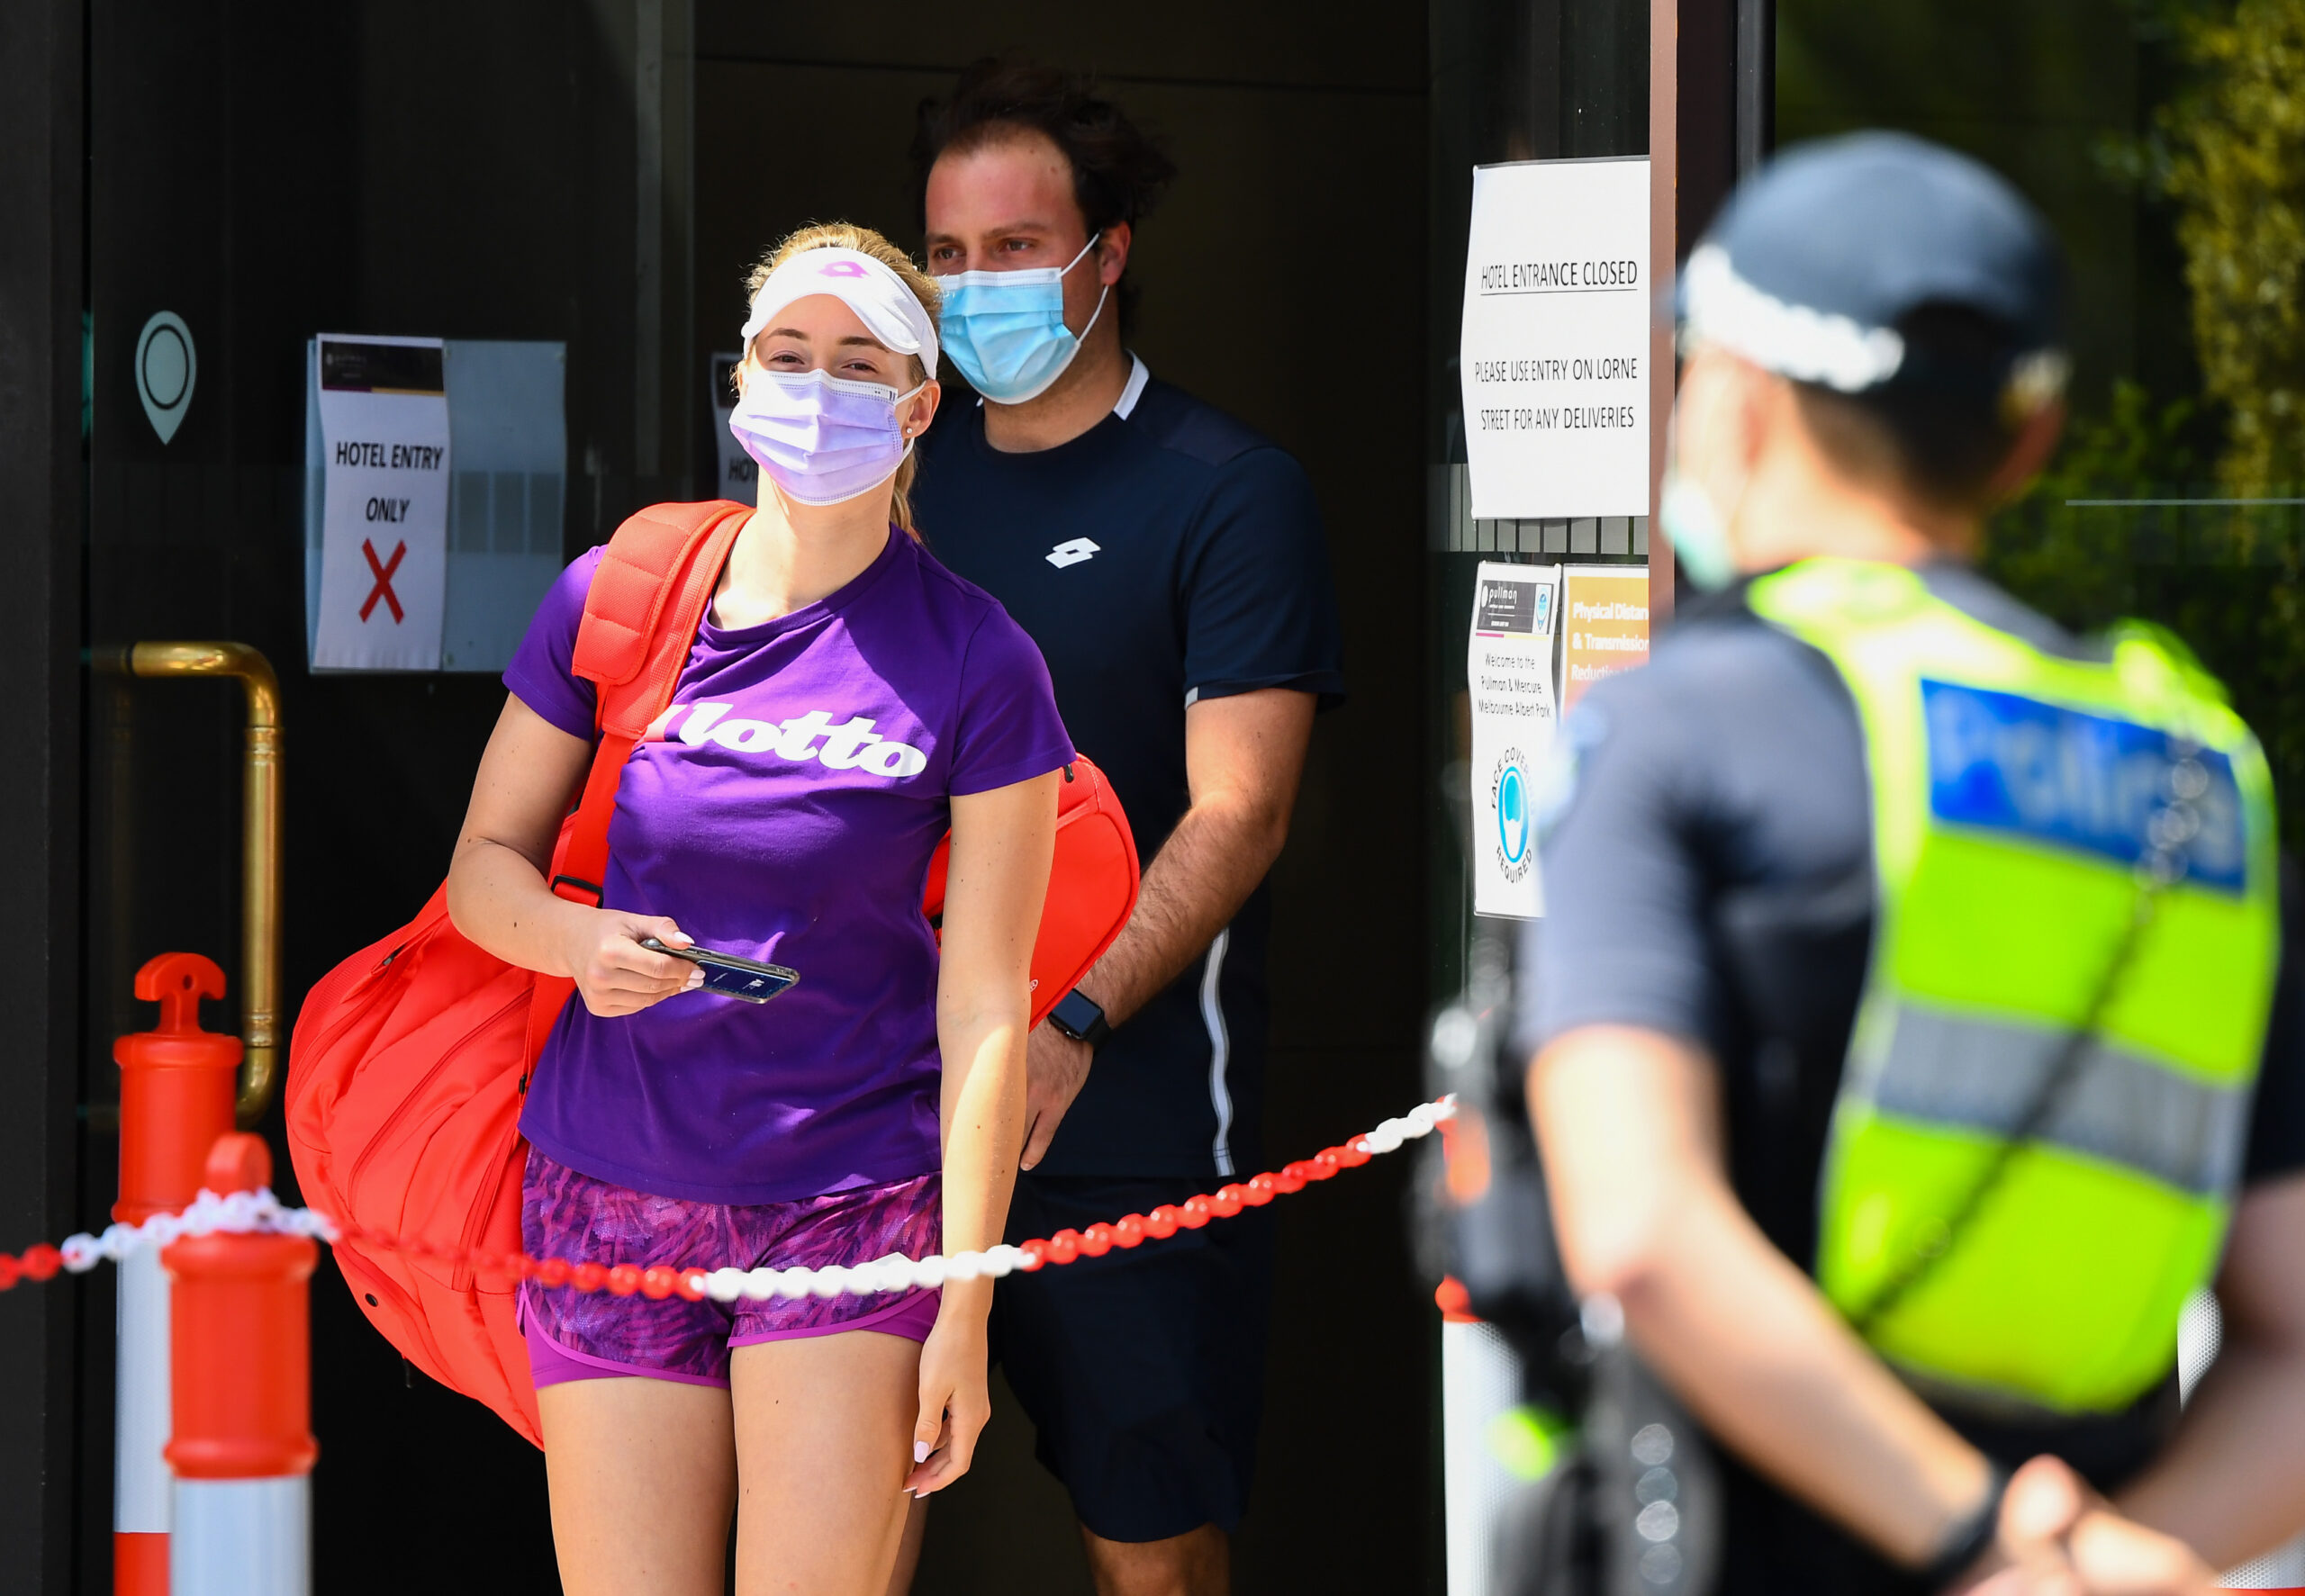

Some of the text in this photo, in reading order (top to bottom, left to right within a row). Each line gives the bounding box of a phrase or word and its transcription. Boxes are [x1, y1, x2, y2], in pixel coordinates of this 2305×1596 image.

[1481, 261, 1637, 289] HOTEL ENTRANCE CLOSED
[1475, 358, 1637, 383] PLEASE USE ENTRY ON LORNE
[1481, 407, 1634, 430] STREET FOR ANY DELIVERIES
[336, 441, 444, 470] HOTEL ENTRY
[366, 496, 411, 523] ONLY
[1488, 586, 1517, 605] pullman
[1573, 601, 1614, 623] Physical
[1572, 632, 1582, 650] &
[1485, 653, 1514, 668] Welcome
[1481, 675, 1507, 691] Pullman
[1514, 678, 1541, 694] Mercure
[1479, 699, 1550, 718] Melbourne Albert Park
[678, 702, 927, 778] lotto
[1491, 758, 1503, 809] FACE
[1496, 845, 1532, 884] REQUIRED
